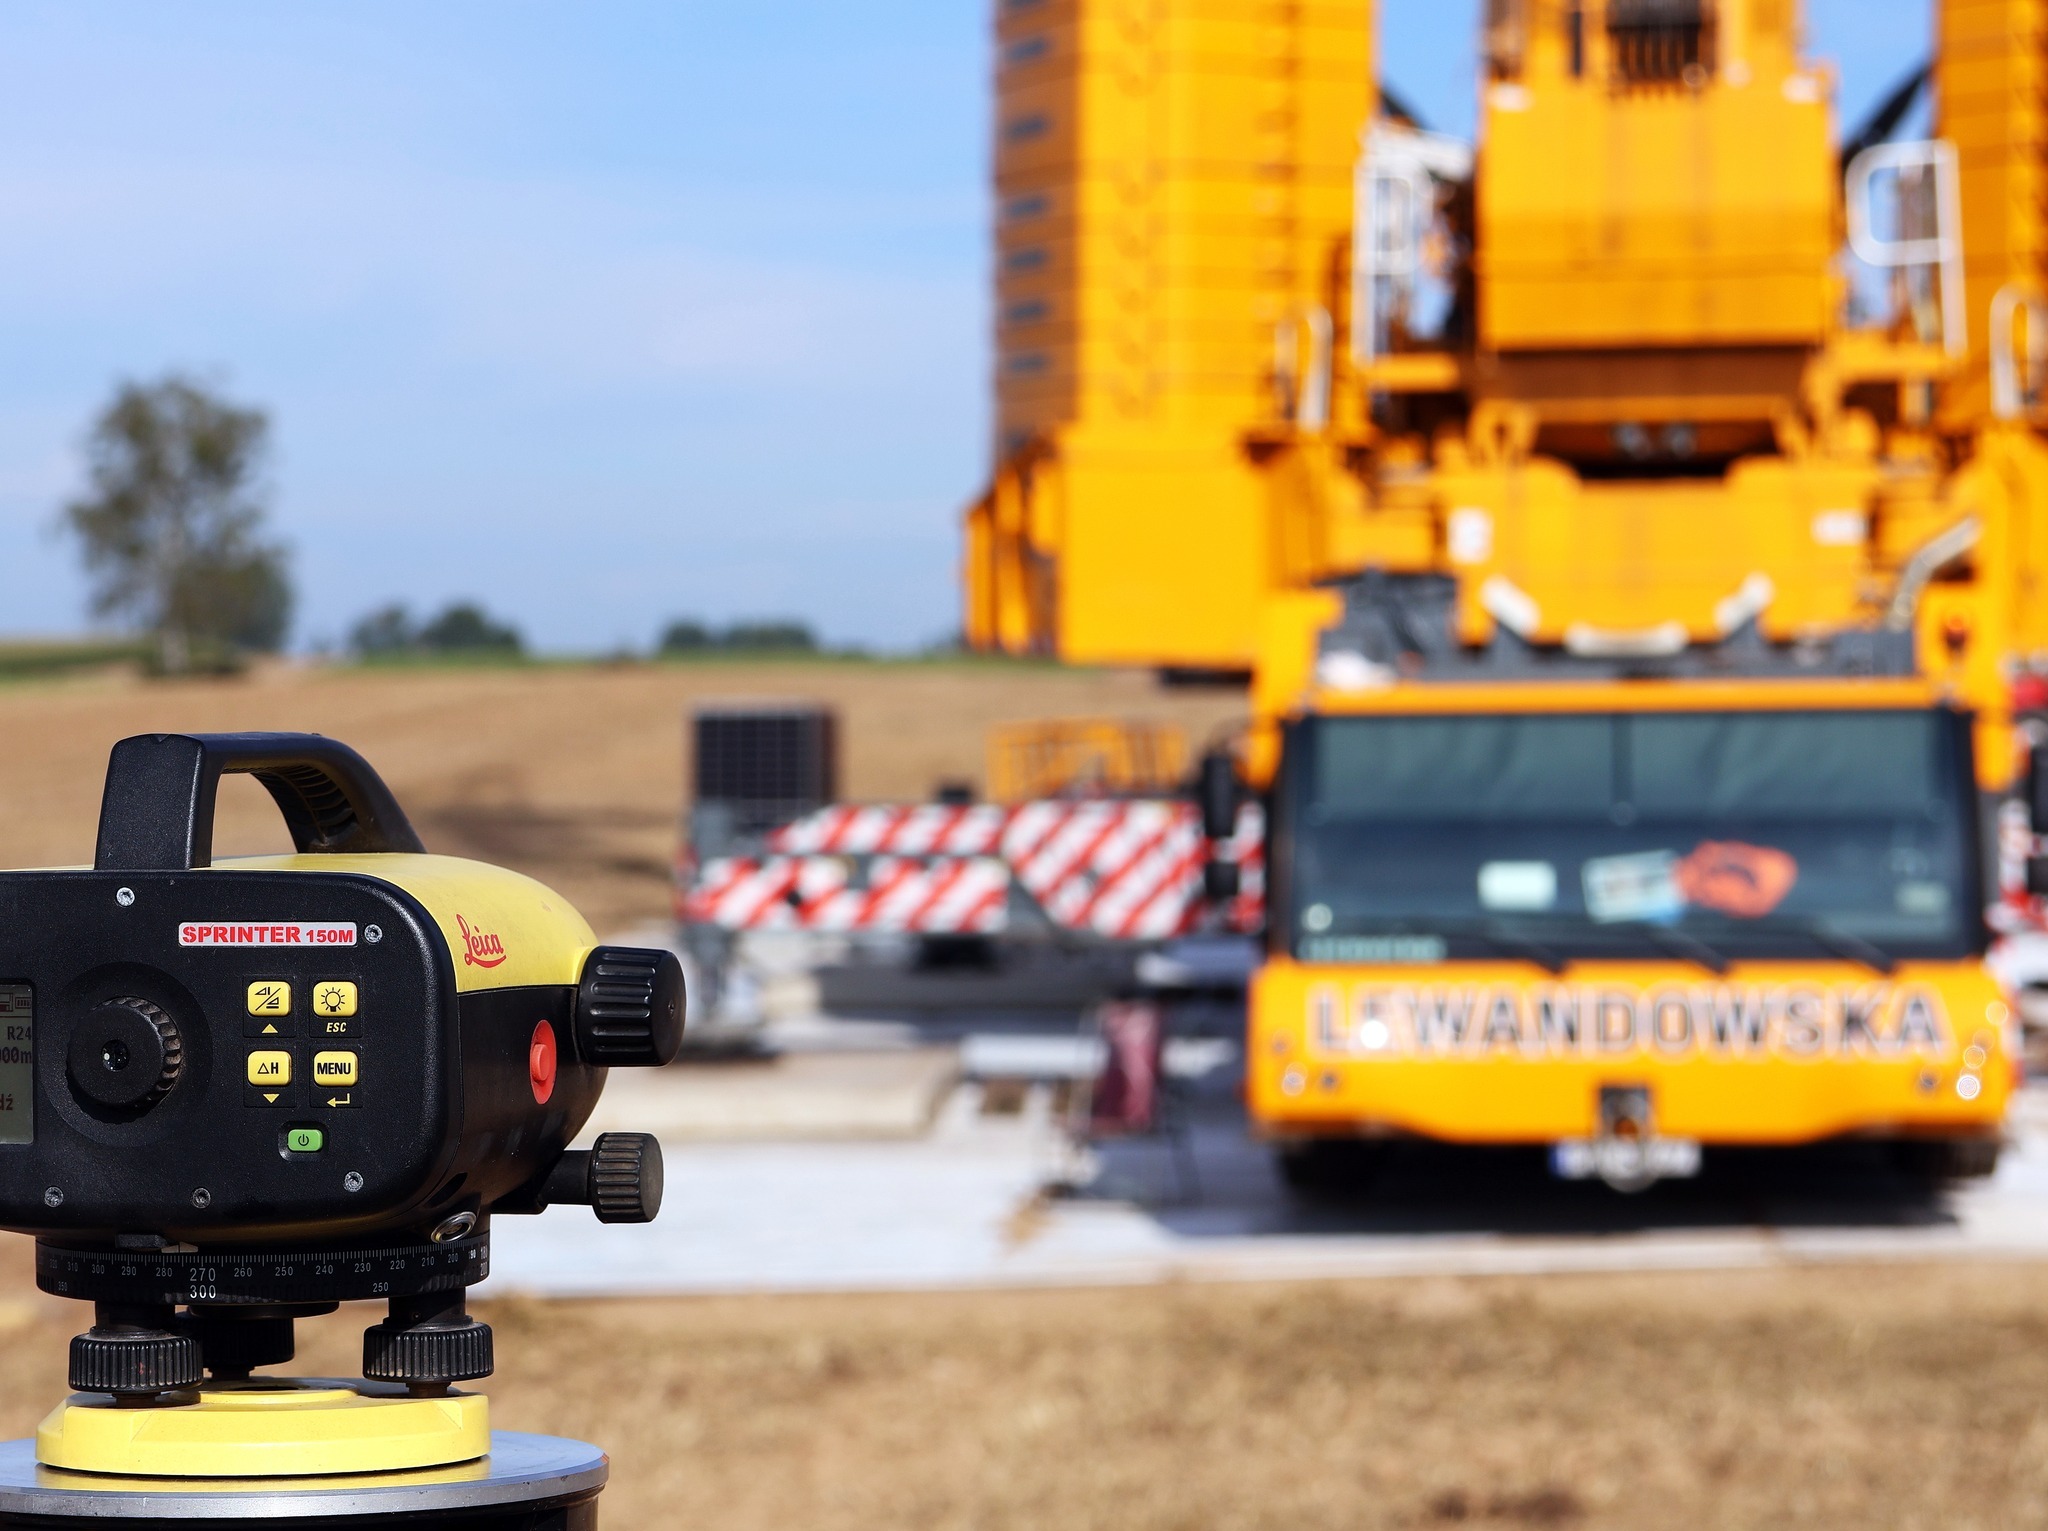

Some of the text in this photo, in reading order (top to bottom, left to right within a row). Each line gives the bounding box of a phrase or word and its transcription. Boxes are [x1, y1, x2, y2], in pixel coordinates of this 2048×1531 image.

[182, 926, 353, 943] SPRINTER 150M
[456, 914, 506, 968] Leica
[326, 1022, 347, 1033] ESC
[1314, 990, 1946, 1054] LEWANDOWSKA
[7, 1026, 31, 1040] R24
[0, 1047, 32, 1064] 00m
[317, 1062, 351, 1075] MENU
[67, 1261, 79, 1272] 310
[91, 1264, 105, 1275] 300
[121, 1266, 137, 1276] 290
[155, 1267, 173, 1277] 280
[189, 1267, 216, 1282] 270
[233, 1267, 253, 1278] 260
[275, 1266, 294, 1277] 250
[315, 1264, 334, 1275] 240
[354, 1262, 371, 1273] 230
[390, 1259, 406, 1270] 220
[421, 1256, 435, 1267] 210
[447, 1252, 459, 1264] 200
[189, 1284, 217, 1299] 300
[372, 1281, 389, 1293] 250
